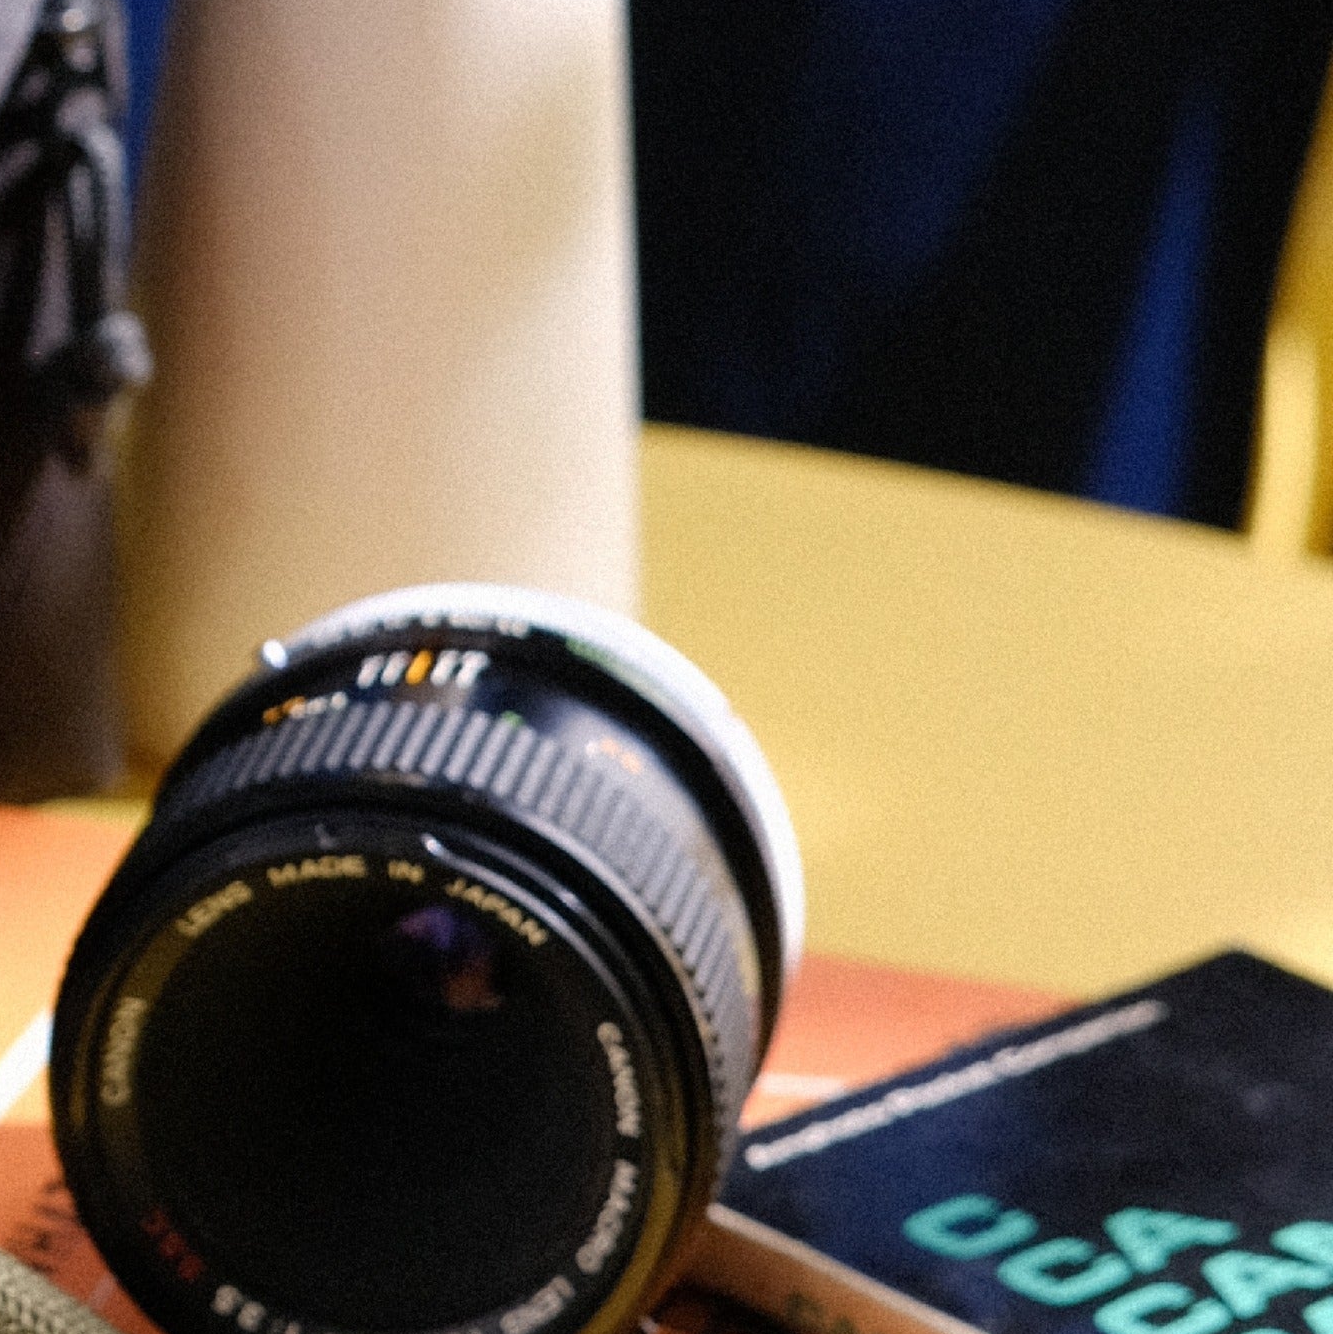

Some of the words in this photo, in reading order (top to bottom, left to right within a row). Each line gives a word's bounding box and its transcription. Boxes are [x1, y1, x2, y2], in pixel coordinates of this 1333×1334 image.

[100, 996, 149, 1107] CANON
[177, 879, 253, 938] LENS
[267, 854, 367, 887] MADE
[388, 858, 425, 884] IN
[444, 877, 549, 947] JAPAN
[596, 1021, 641, 1138] CANON
[574, 1158, 641, 1276] MACRO
[902, 1192, 1041, 1262] C
